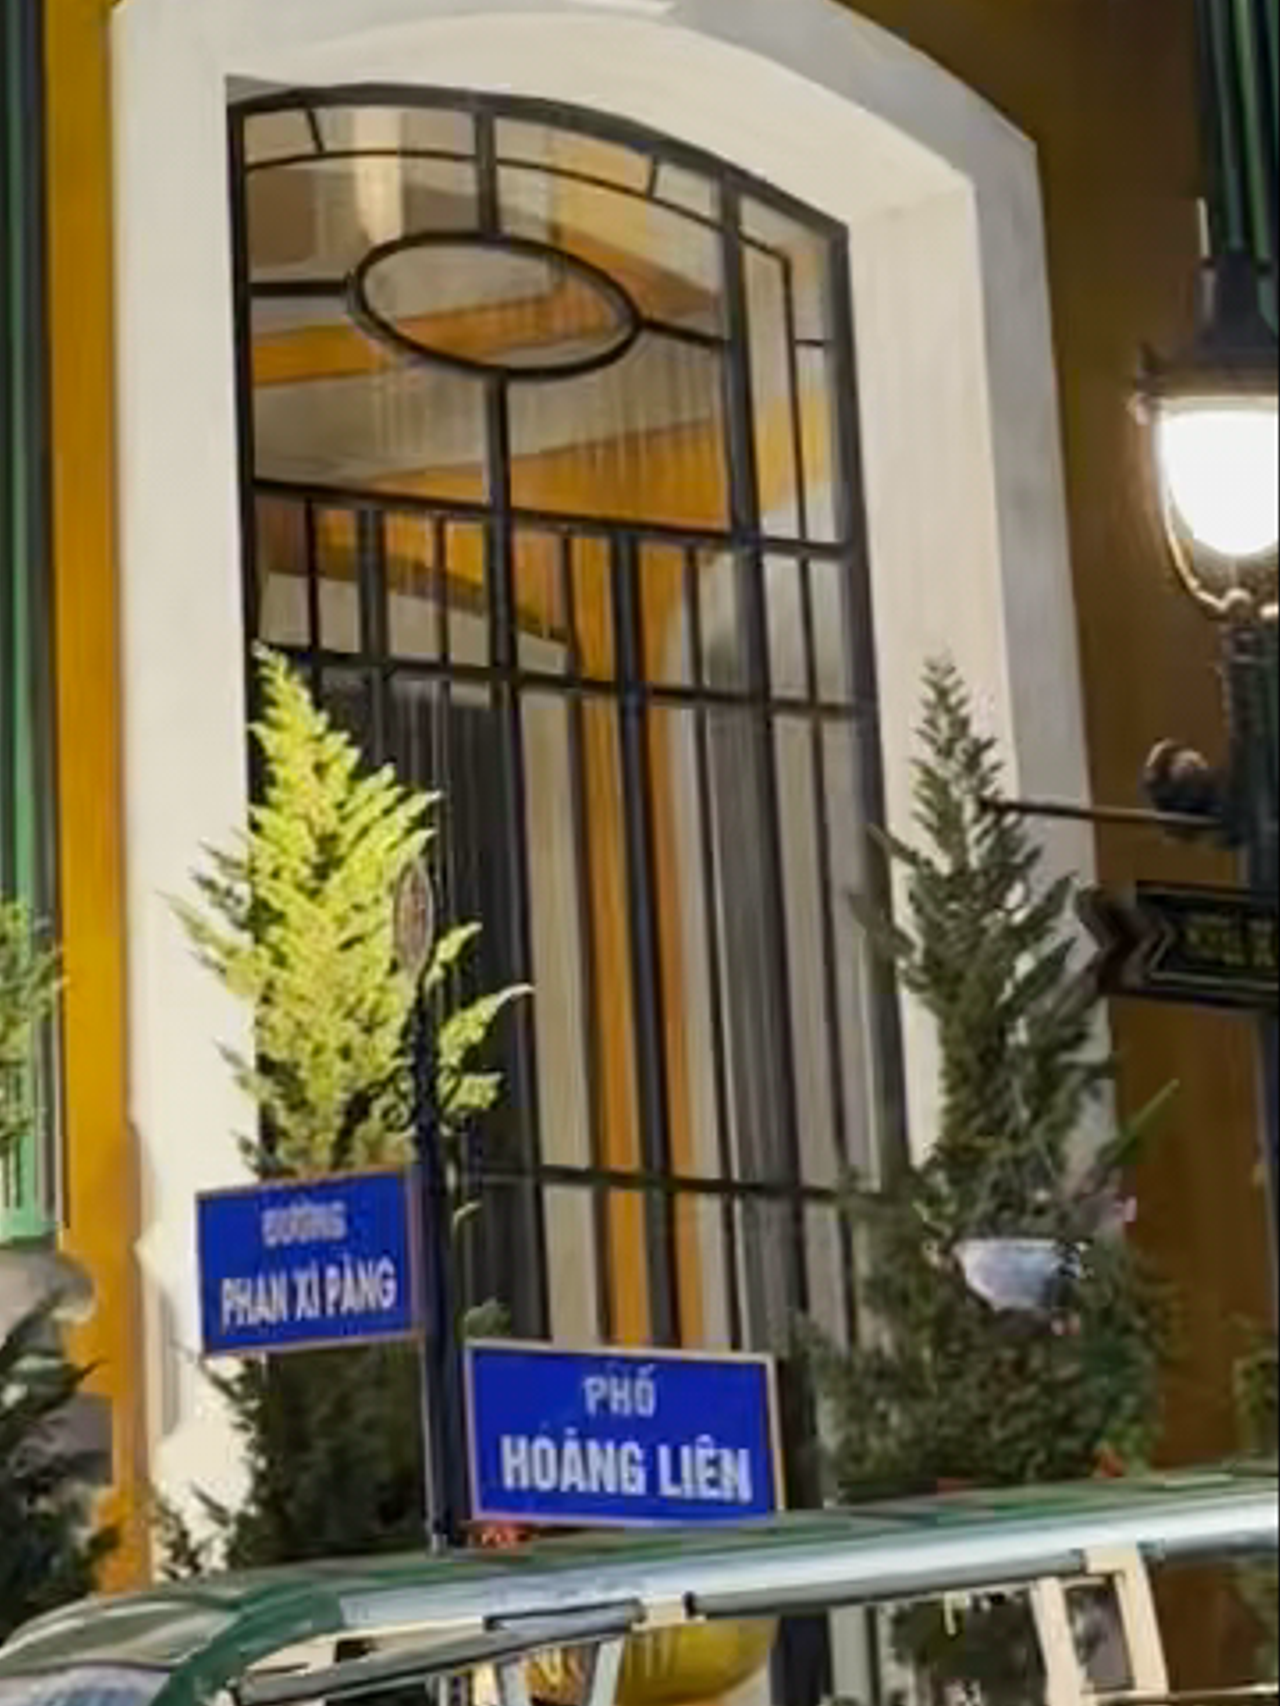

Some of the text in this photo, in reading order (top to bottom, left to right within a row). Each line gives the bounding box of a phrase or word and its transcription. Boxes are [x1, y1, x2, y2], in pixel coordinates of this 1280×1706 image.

[222, 1270, 288, 1327] PHAN
[583, 1362, 657, 1417] PHỐ
[500, 1426, 753, 1503] HOÀNG LIÊN
